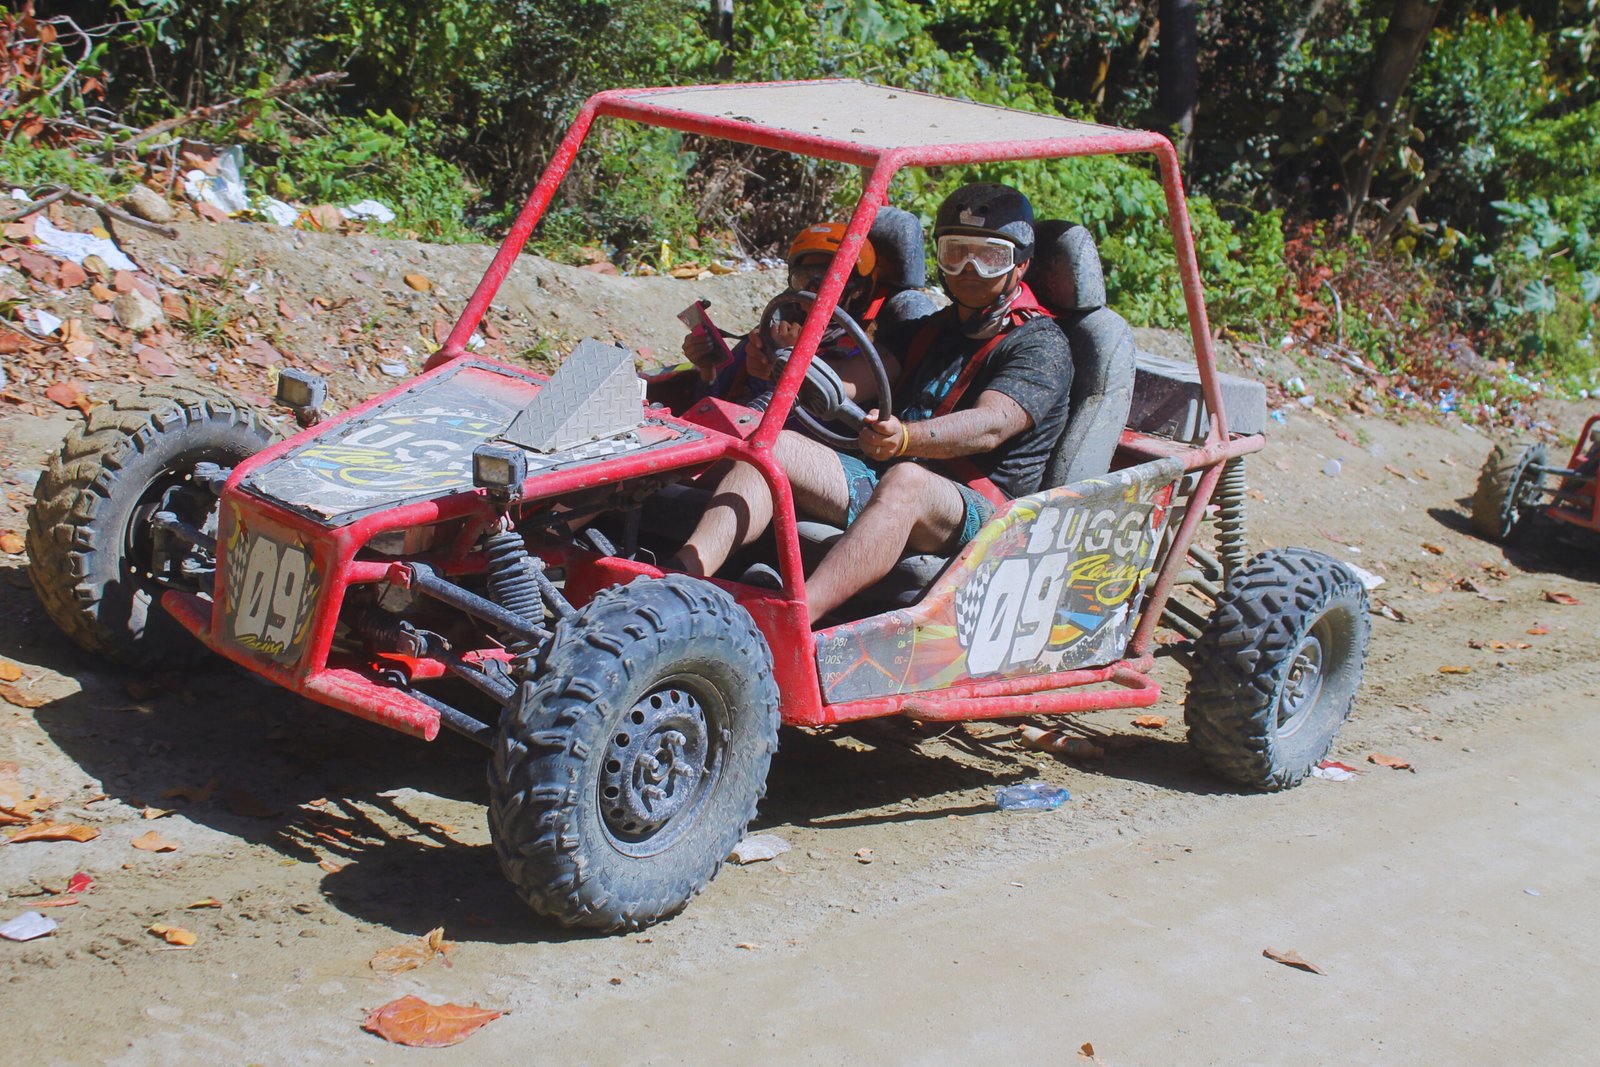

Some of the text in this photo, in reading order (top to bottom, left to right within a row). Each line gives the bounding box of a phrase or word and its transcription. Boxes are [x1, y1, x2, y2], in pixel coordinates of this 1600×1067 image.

[1027, 506, 1167, 560] BUGGY
[234, 536, 306, 651] 09
[967, 552, 1068, 674] 09
[1066, 554, 1152, 605] Racing
